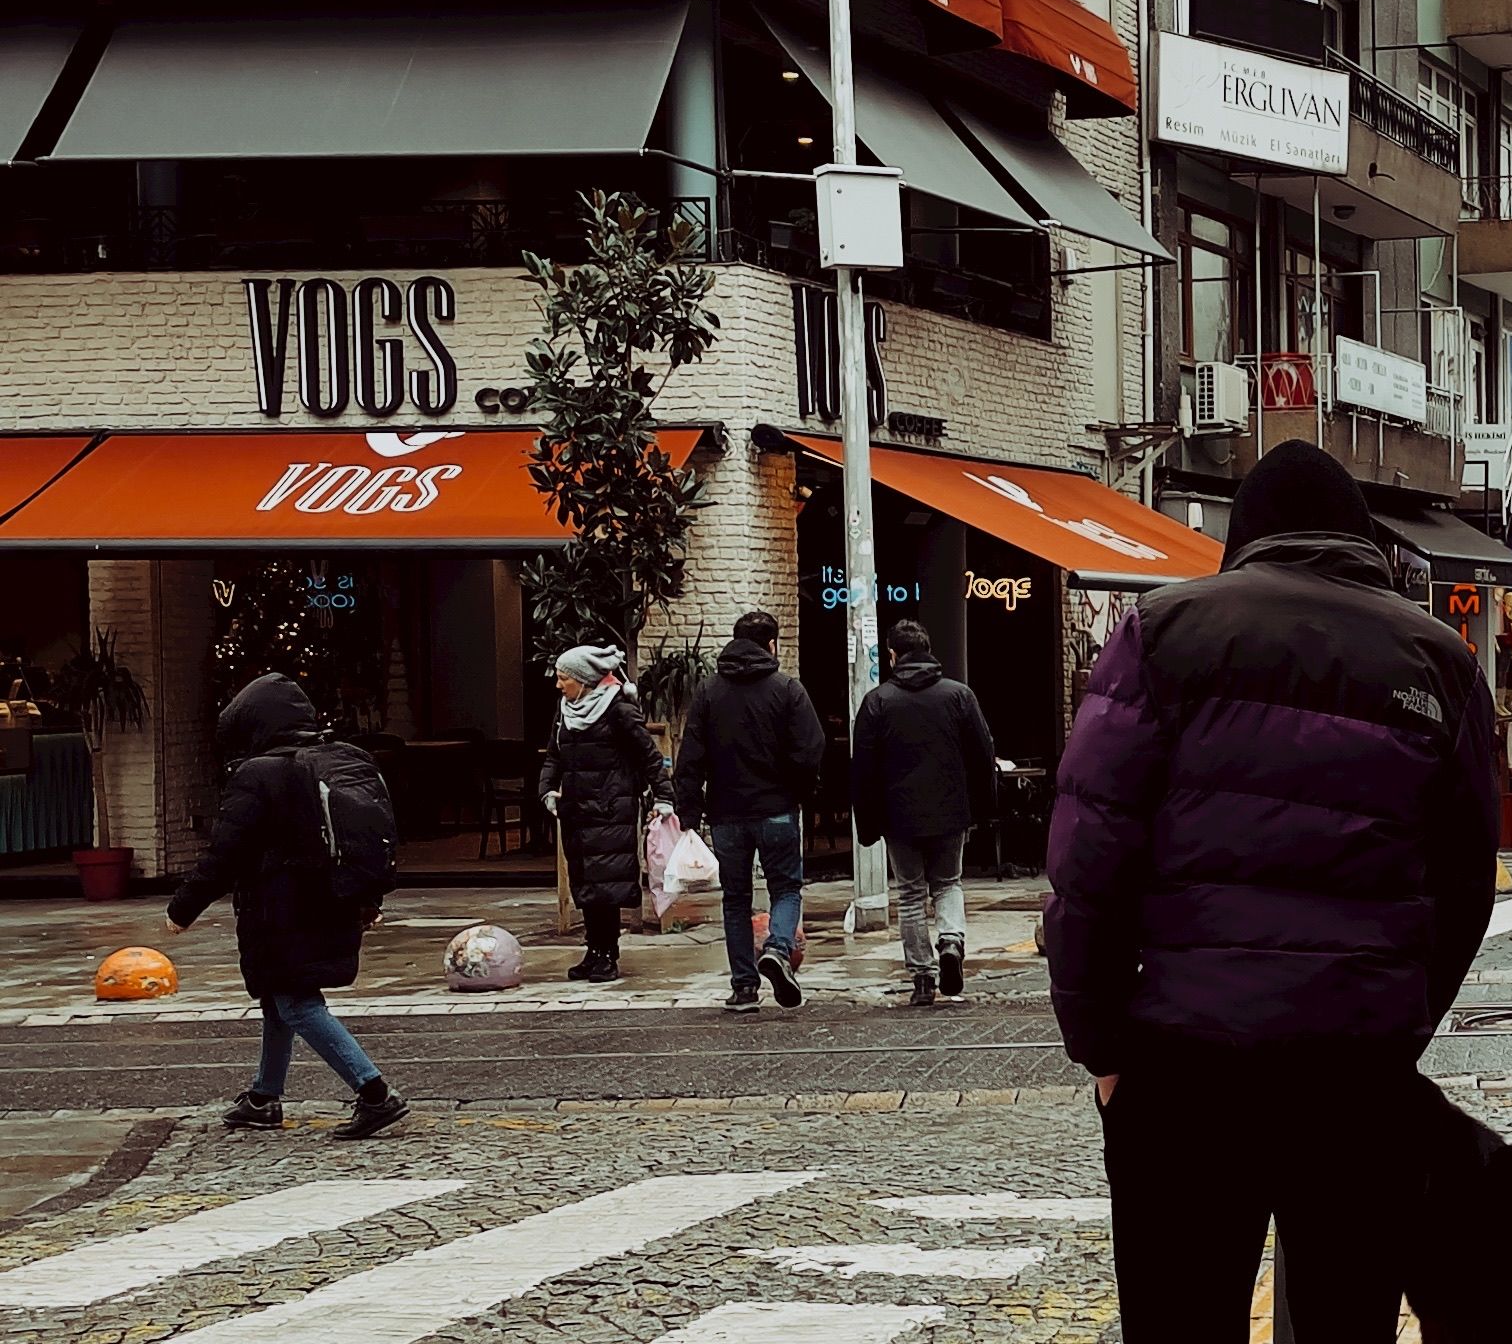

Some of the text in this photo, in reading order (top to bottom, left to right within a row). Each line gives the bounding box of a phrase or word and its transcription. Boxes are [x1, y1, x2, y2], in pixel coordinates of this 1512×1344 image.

[1222, 74, 1341, 128] ERGUVAN
[241, 275, 458, 418] VOGS
[256, 462, 463, 515] VOGS
